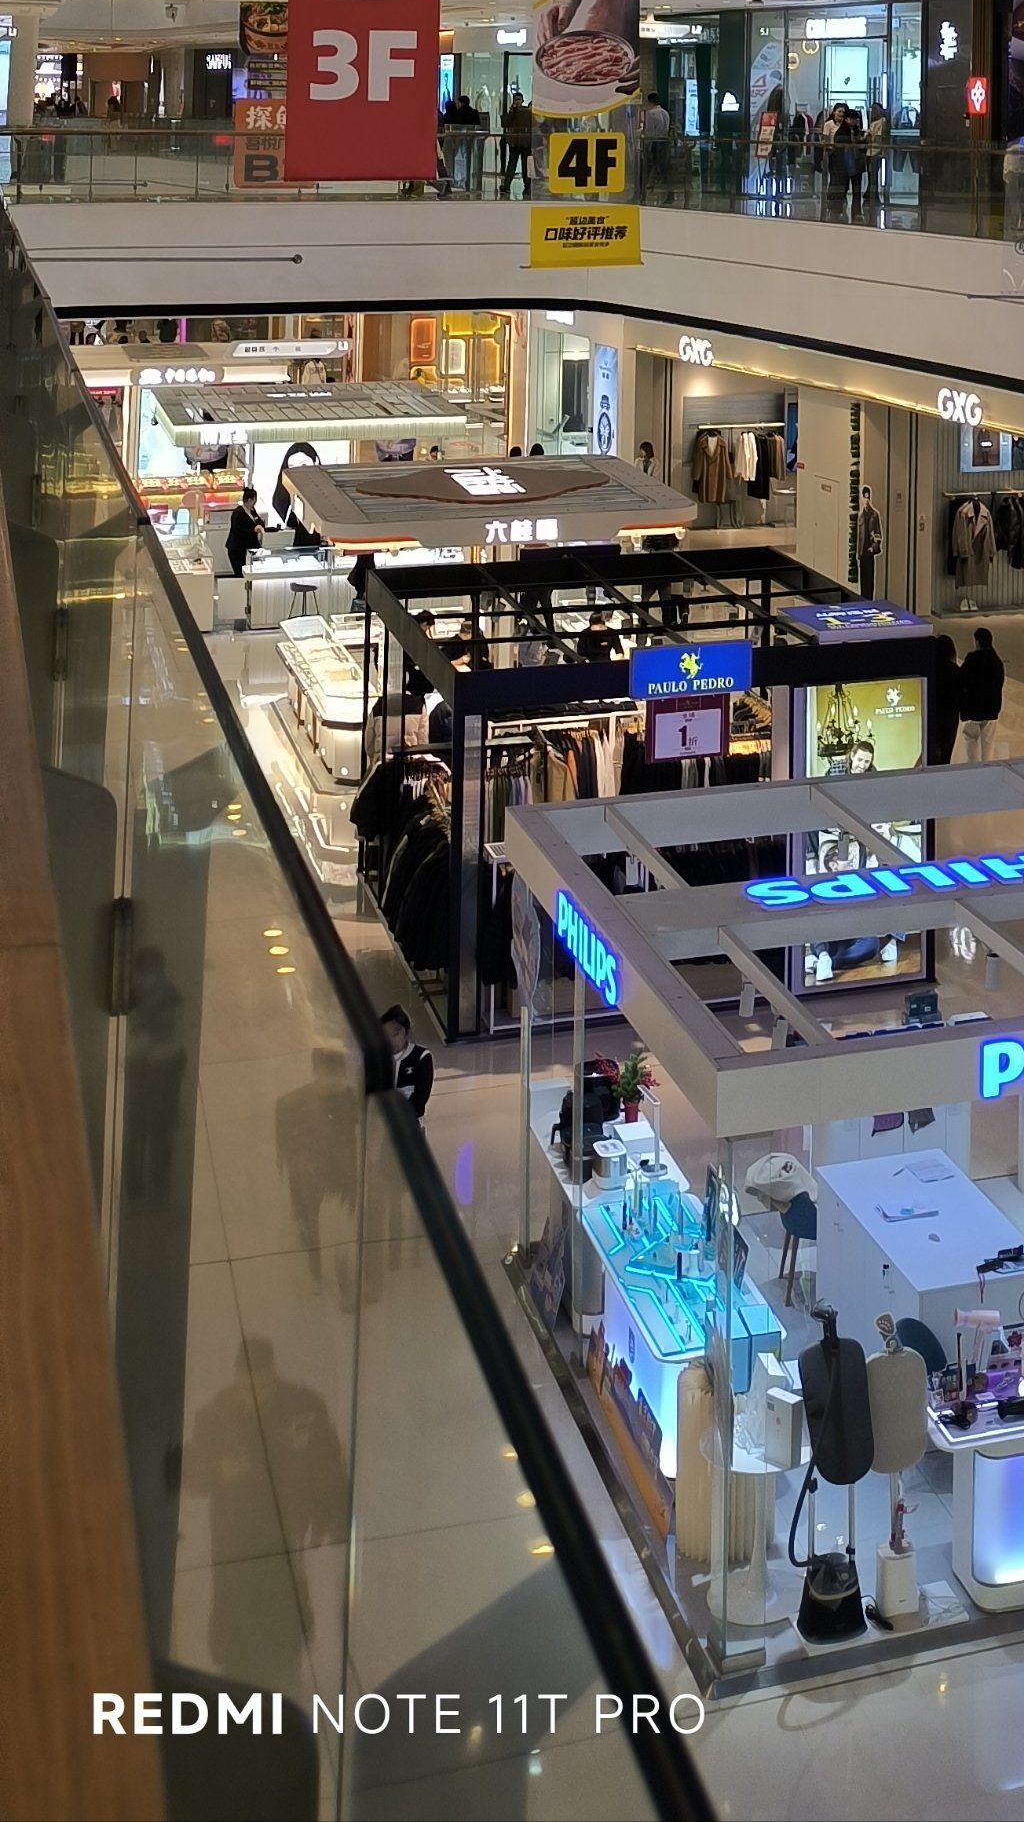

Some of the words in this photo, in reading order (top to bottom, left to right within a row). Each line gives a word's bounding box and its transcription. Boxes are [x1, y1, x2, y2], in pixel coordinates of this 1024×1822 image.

[309, 29, 418, 102] 3F
[558, 138, 618, 187] 4F
[544, 225, 628, 241] 口味好评推荐
[679, 335, 714, 367] GXG
[937, 388, 983, 426] GXG
[648, 680, 688, 695] PAULO
[693, 676, 735, 691] PEDRO
[557, 891, 618, 1006] PHILIPS
